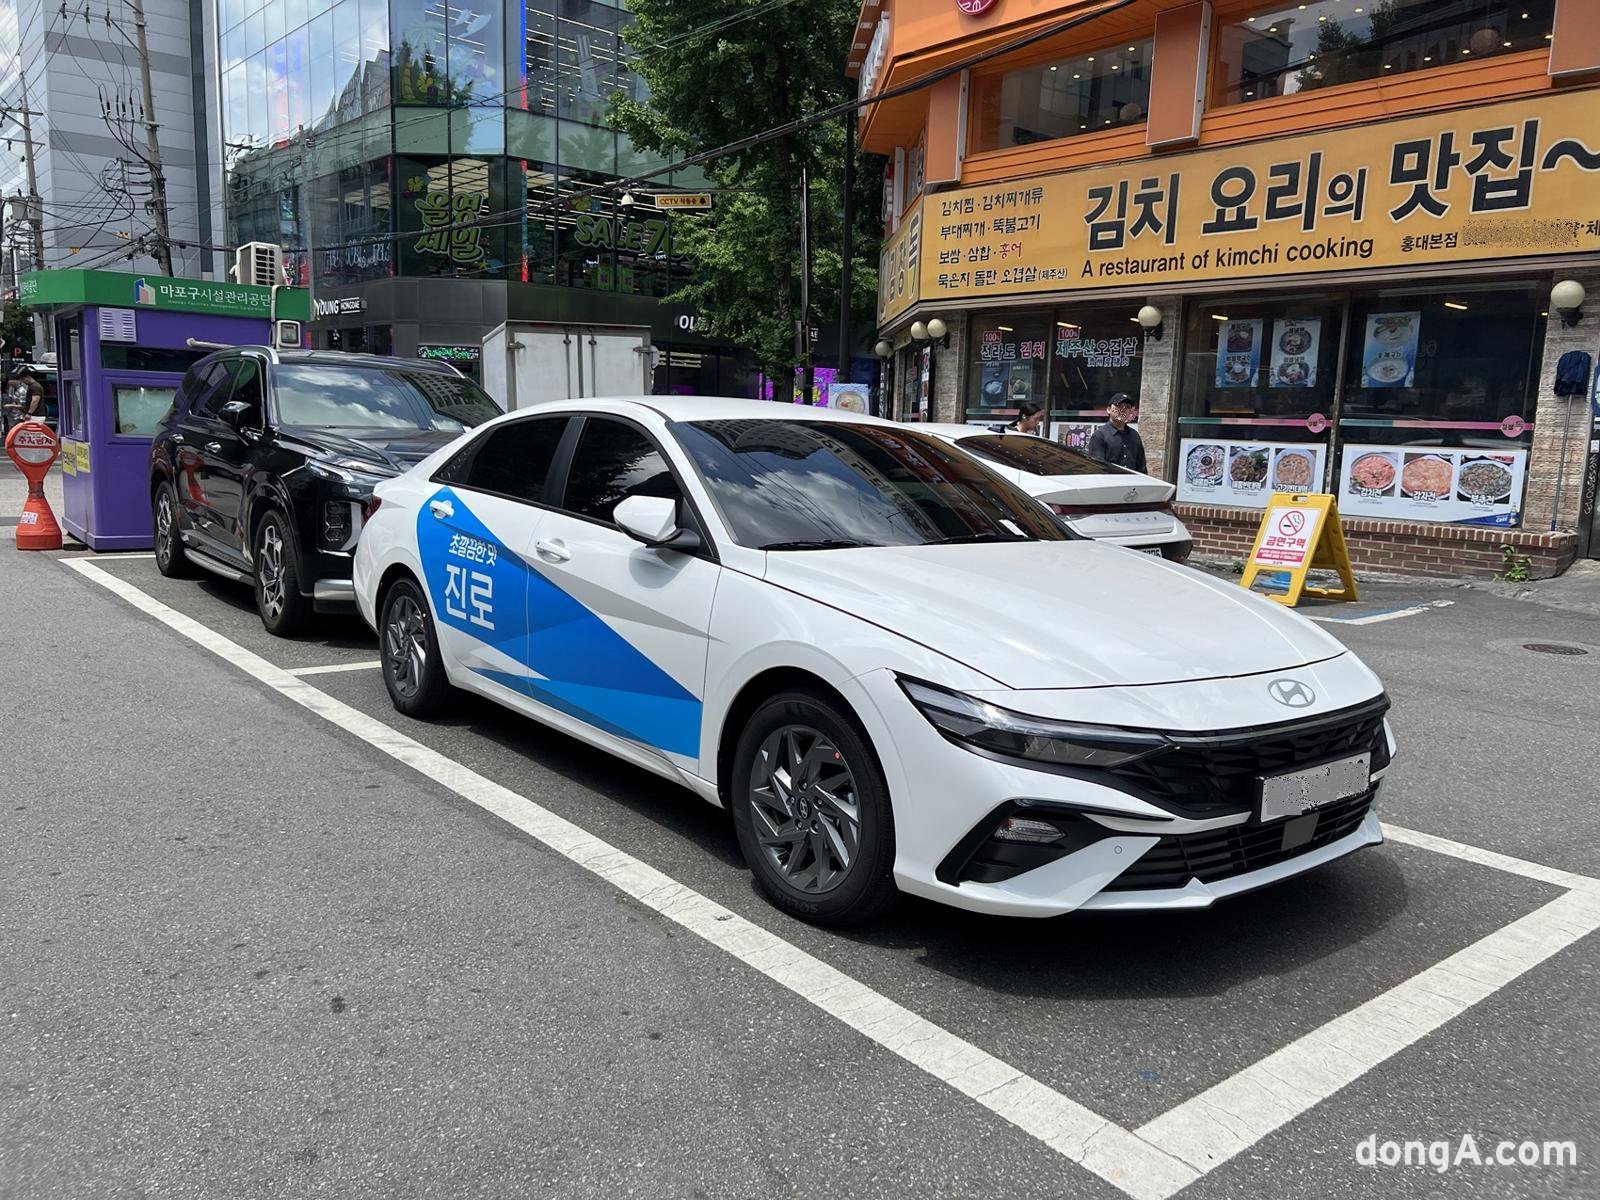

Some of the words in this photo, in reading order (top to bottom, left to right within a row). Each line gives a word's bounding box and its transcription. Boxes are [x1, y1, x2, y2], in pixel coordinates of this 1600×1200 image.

[1083, 172, 1181, 251] 김치
[1201, 151, 1367, 235] 요리의
[575, 214, 645, 252] SALE
[1401, 232, 1458, 252] 홍대본점
[1081, 259, 1093, 278] A
[1099, 252, 1185, 277] restaurant
[1191, 248, 1209, 269] of
[1215, 242, 1279, 268] kimchi
[1286, 236, 1375, 262] cooking
[938, 272, 970, 288] 묵은지
[974, 270, 997, 286] 돌판
[159, 284, 271, 307] 마포구시설관리공단
[313, 299, 339, 316] YOUNG
[980, 342, 1016, 361] 전라도
[1019, 340, 1046, 360] 김치
[448, 533, 487, 563] 초깔끔한
[485, 544, 497, 567] 맛
[1266, 535, 1307, 549] 금연구역
[444, 564, 495, 631] 진로
